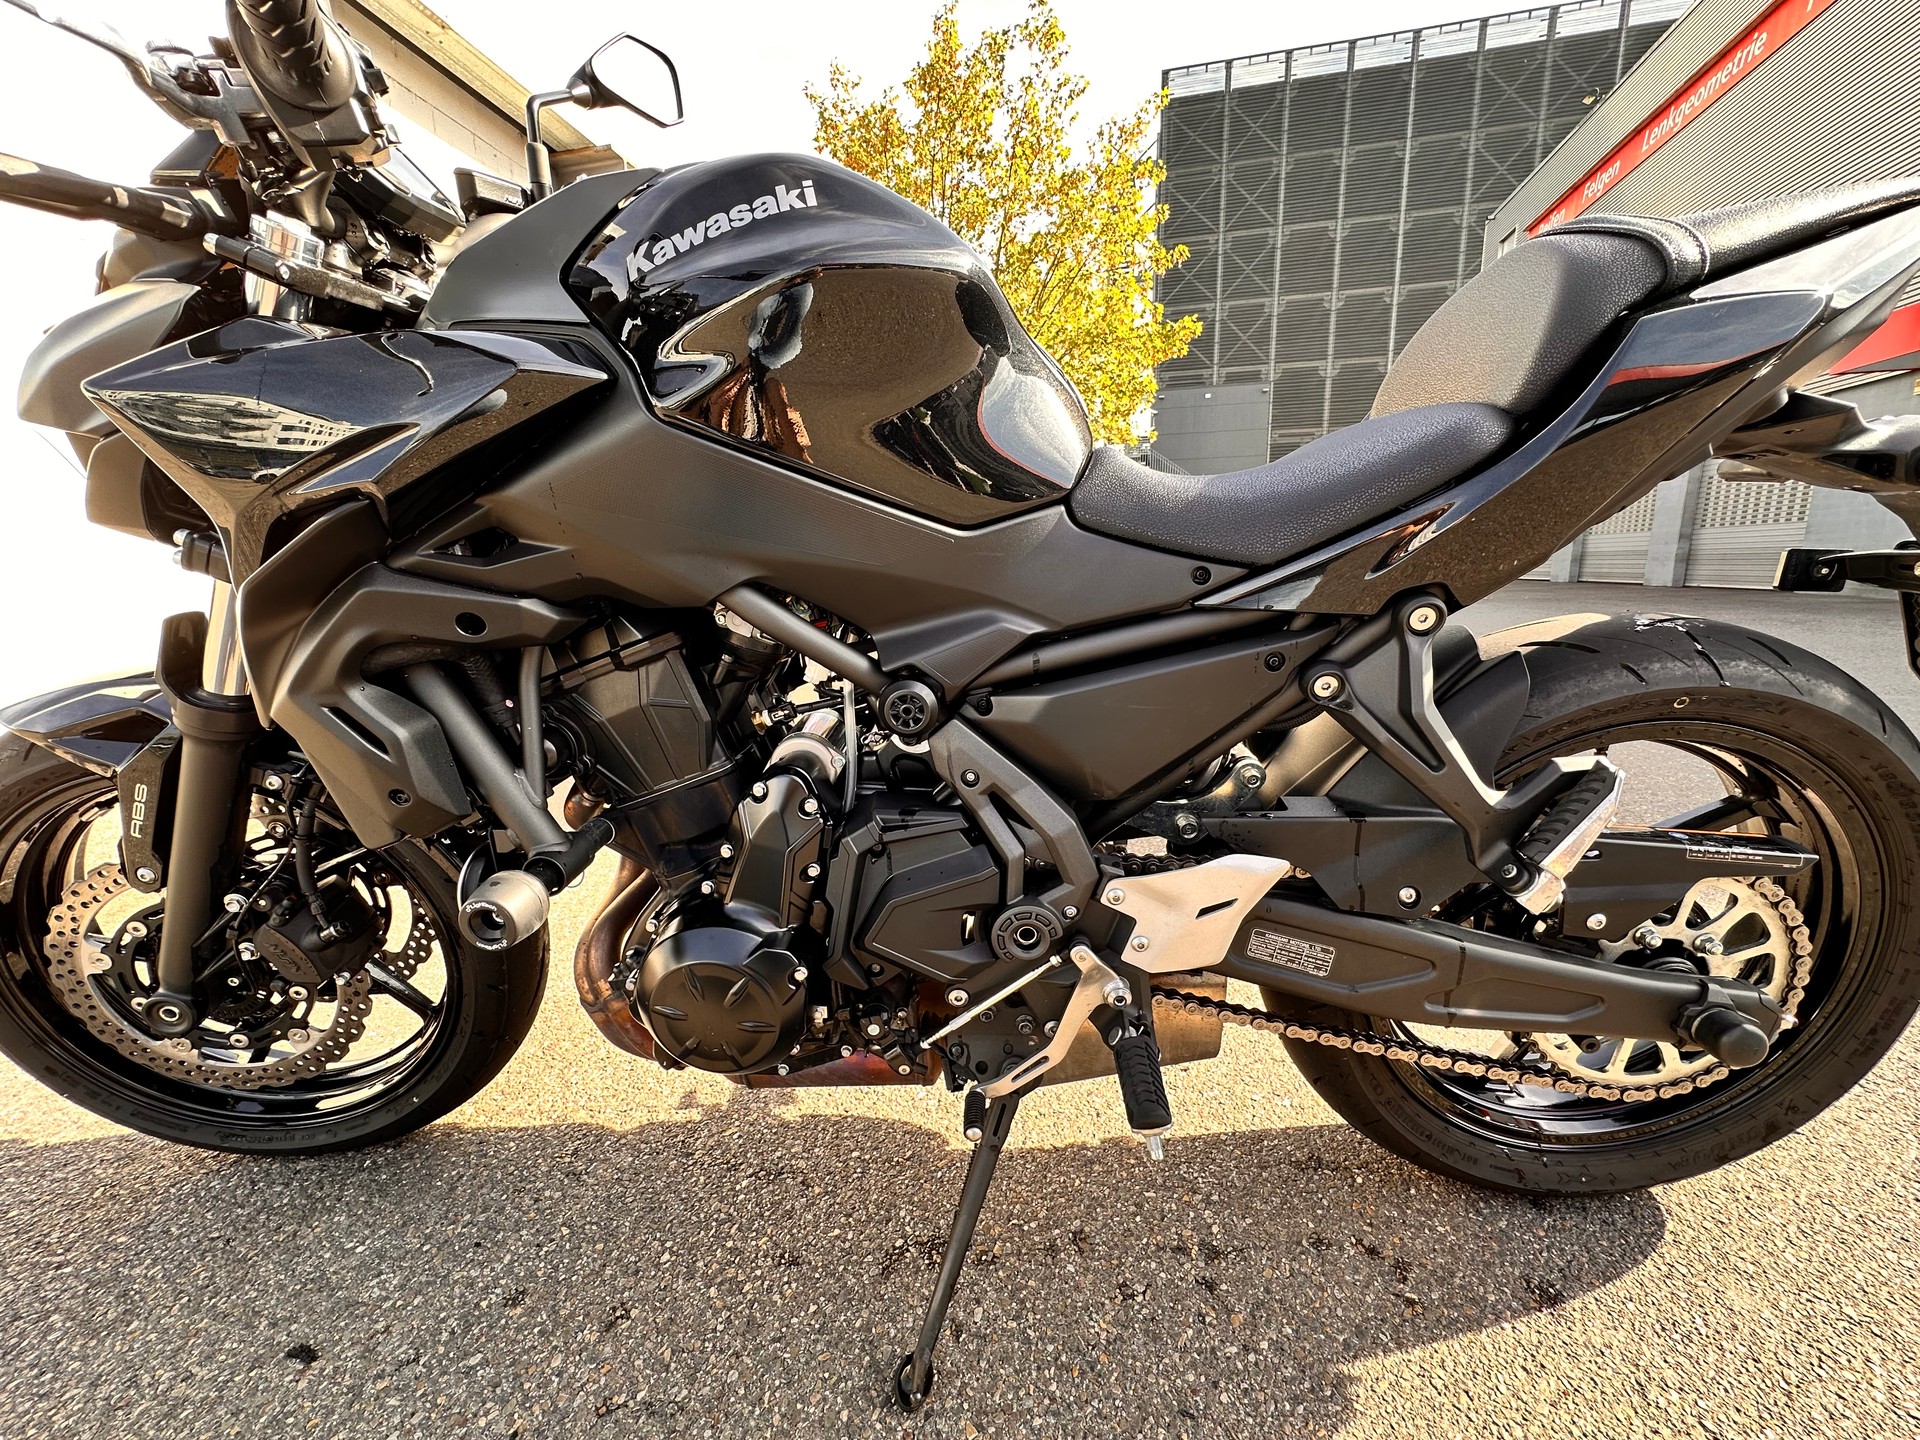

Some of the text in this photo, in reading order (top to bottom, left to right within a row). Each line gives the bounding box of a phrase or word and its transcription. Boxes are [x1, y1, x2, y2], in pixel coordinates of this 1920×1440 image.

[1582, 159, 1621, 204] Felgen
[1641, 31, 1768, 152] Lenkgeometrie
[626, 180, 818, 282] Kawasaki
[130, 783, 148, 838] ABS
